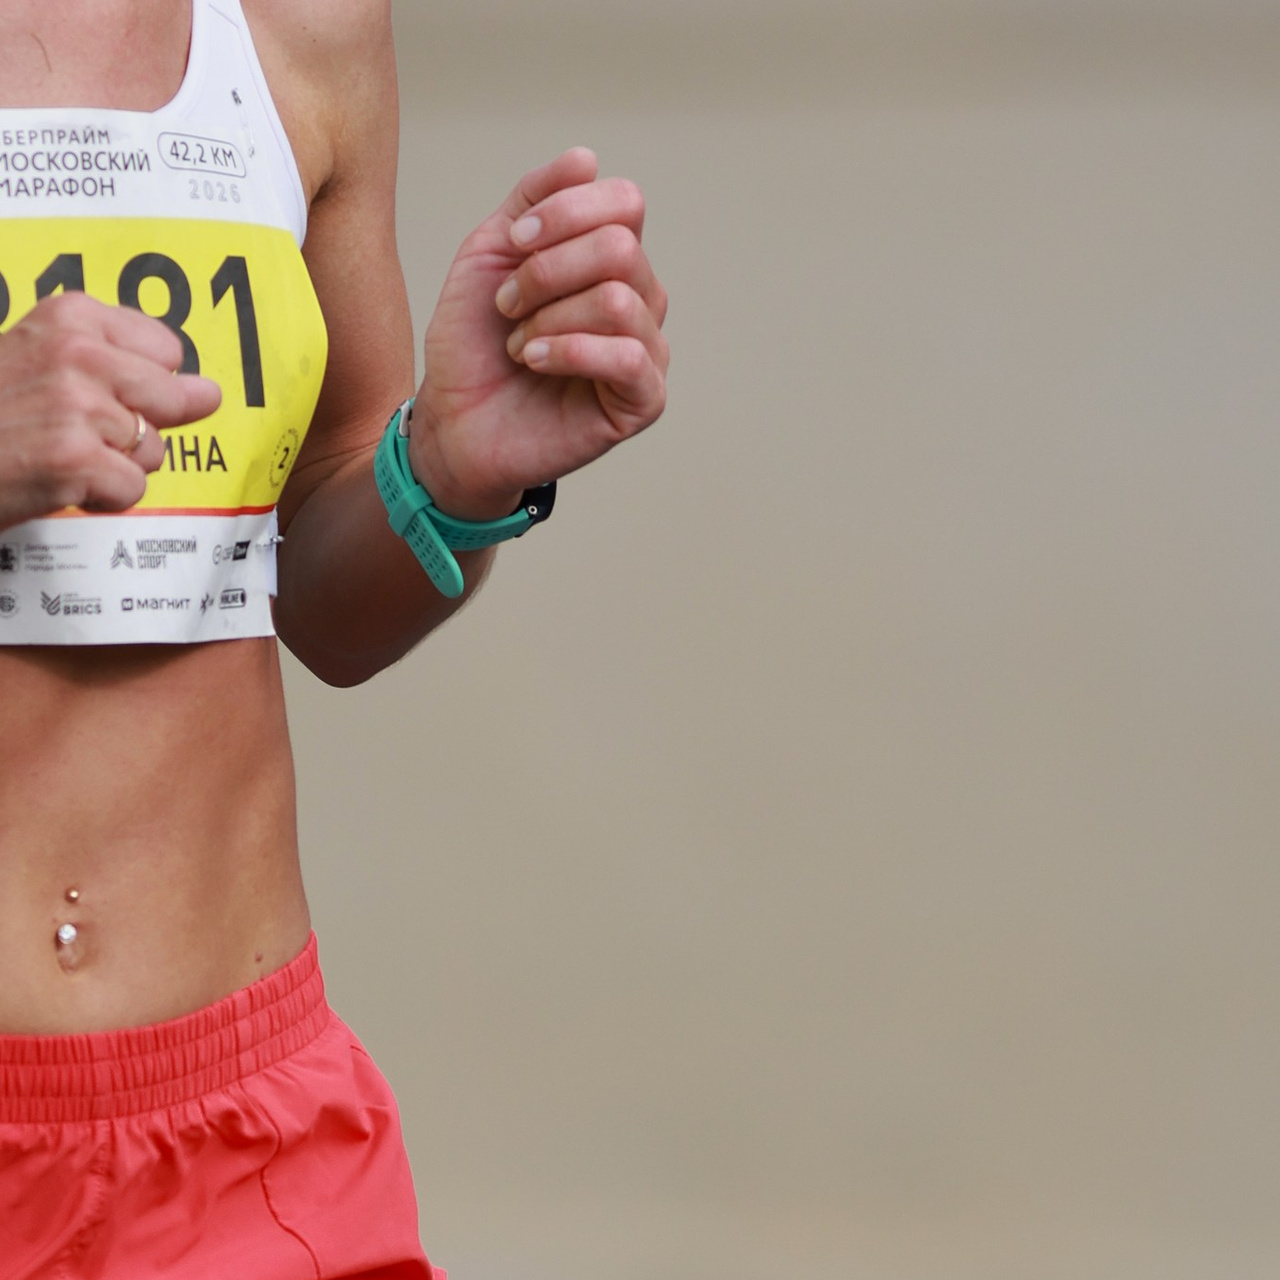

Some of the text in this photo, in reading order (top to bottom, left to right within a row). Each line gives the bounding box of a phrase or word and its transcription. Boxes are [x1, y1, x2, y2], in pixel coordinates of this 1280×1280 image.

[170, 140, 207, 166] 42,2
[188, 179, 241, 203] 2026
[136, 536, 197, 554] МОСКОВСКИЙ
[138, 555, 167, 569] СПОРТ
